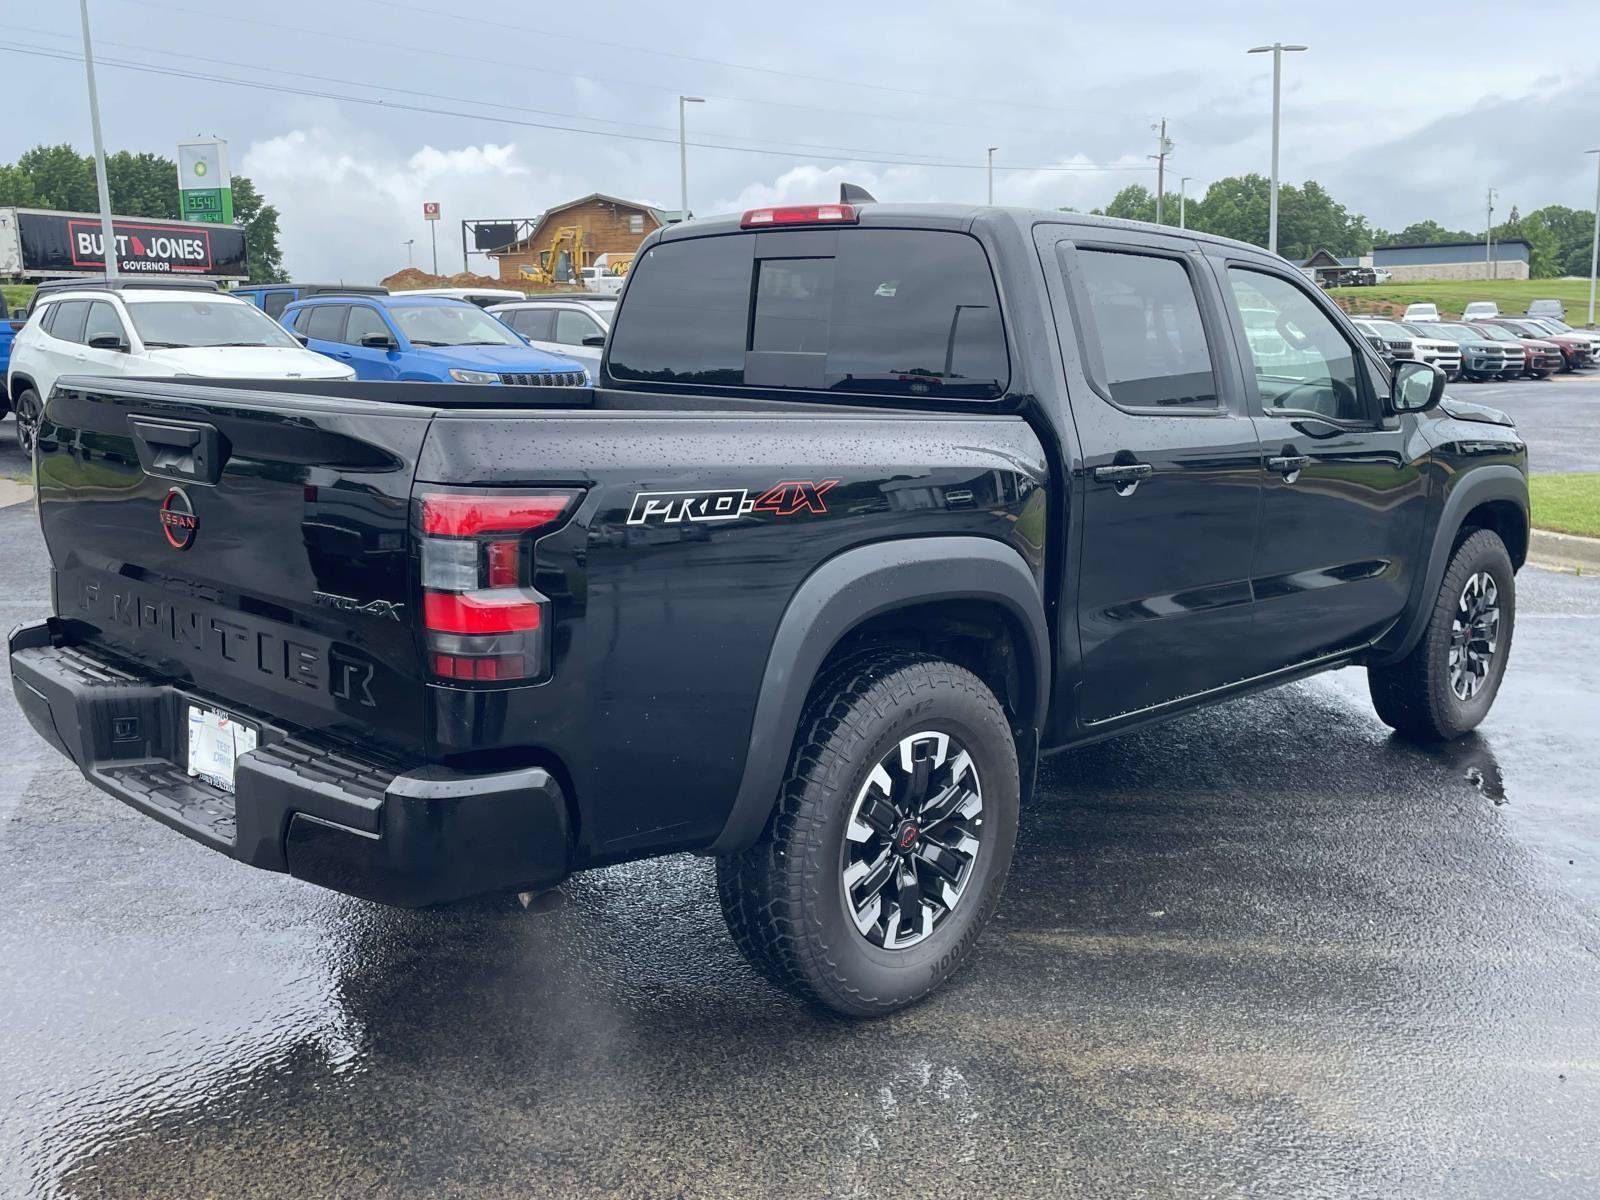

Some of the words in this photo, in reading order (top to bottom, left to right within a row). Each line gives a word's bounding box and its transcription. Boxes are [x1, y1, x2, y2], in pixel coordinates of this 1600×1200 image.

[146, 237, 204, 260] JONES
[122, 260, 171, 272] GOVERNOR
[160, 511, 195, 529] NISSAN
[80, 584, 377, 708] FRONTIER
[216, 739, 231, 754] TEST
